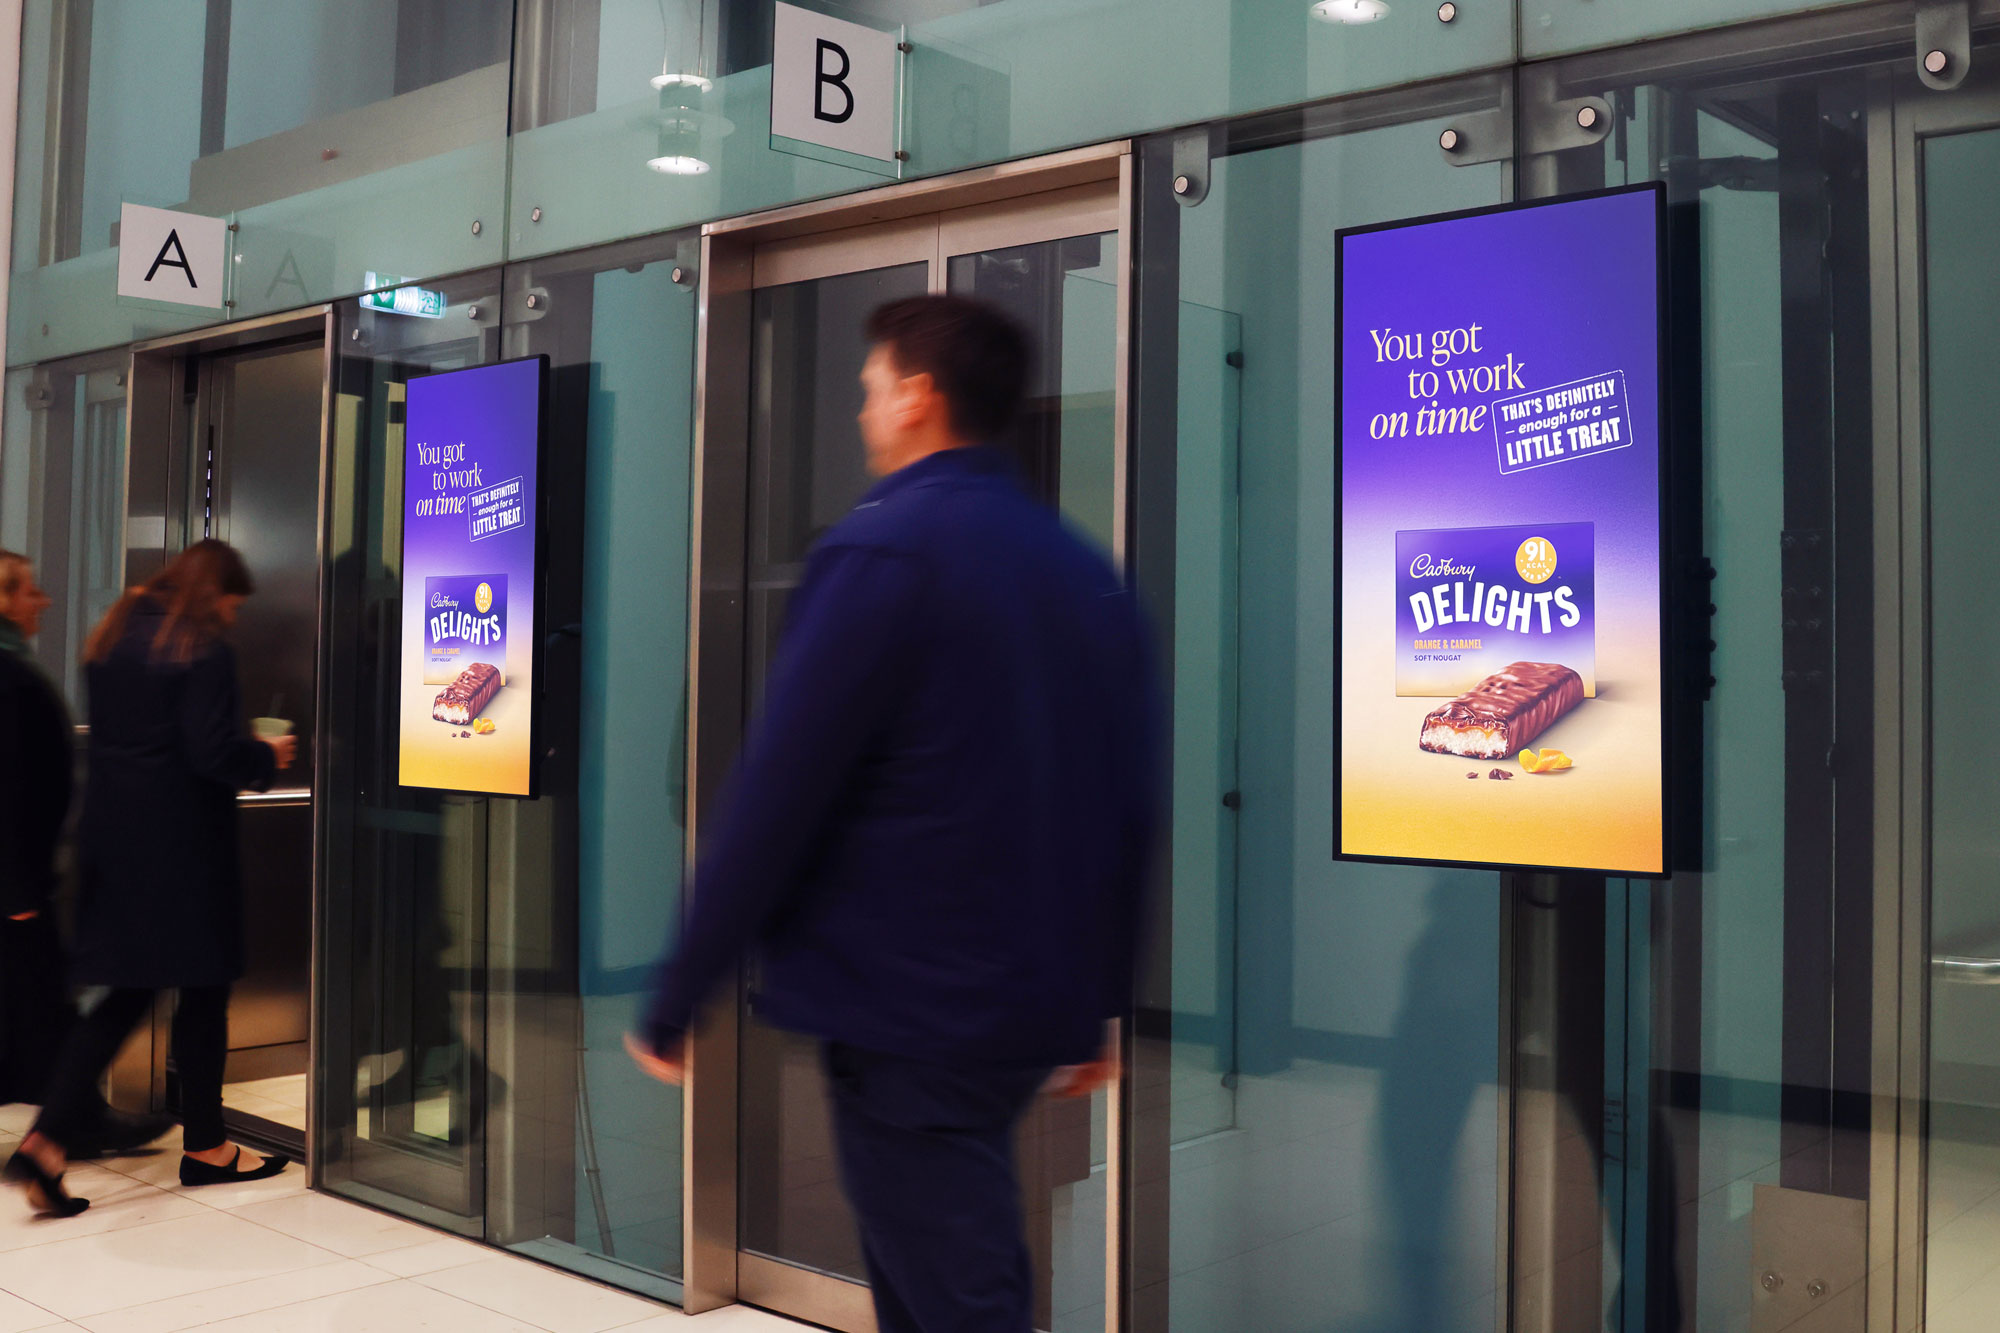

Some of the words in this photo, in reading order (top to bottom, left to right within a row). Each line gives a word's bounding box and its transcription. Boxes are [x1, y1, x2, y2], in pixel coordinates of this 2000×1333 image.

[814, 38, 854, 124] B
[144, 228, 198, 288] A
[1370, 328, 1423, 362] You
[1431, 322, 1483, 367] got
[1408, 368, 1439, 399] to
[1446, 353, 1525, 394] work
[1502, 398, 1543, 422] THAT'S
[1546, 378, 1615, 410] DEFINITELY
[1370, 412, 1408, 439] on
[1415, 400, 1487, 437] time
[1519, 414, 1567, 434] enough
[1570, 406, 1589, 423] for
[1592, 405, 1601, 416] a
[417, 442, 440, 466] You
[442, 441, 466, 470] got
[1506, 431, 1564, 466] LITTLE
[1567, 417, 1621, 452] TREAT
[433, 470, 447, 491] to
[449, 461, 483, 488] work
[416, 498, 433, 517] on
[435, 492, 466, 516] time
[490, 481, 519, 502] DEFINITELY
[473, 514, 498, 537] LITTLE
[498, 506, 521, 528] TREAT
[478, 501, 499, 516] enough
[500, 500, 509, 509] for
[1525, 541, 1546, 561] 91
[1410, 553, 1476, 581] Cadbury
[430, 592, 459, 611] Cadbury
[479, 585, 488, 599] 91
[1409, 582, 1580, 634] DELIGHTS
[430, 611, 501, 646] DELIGHTS
[1414, 639, 1441, 650] ORANGE
[1443, 639, 1449, 649] &
[1450, 639, 1483, 649] CARAMEL
